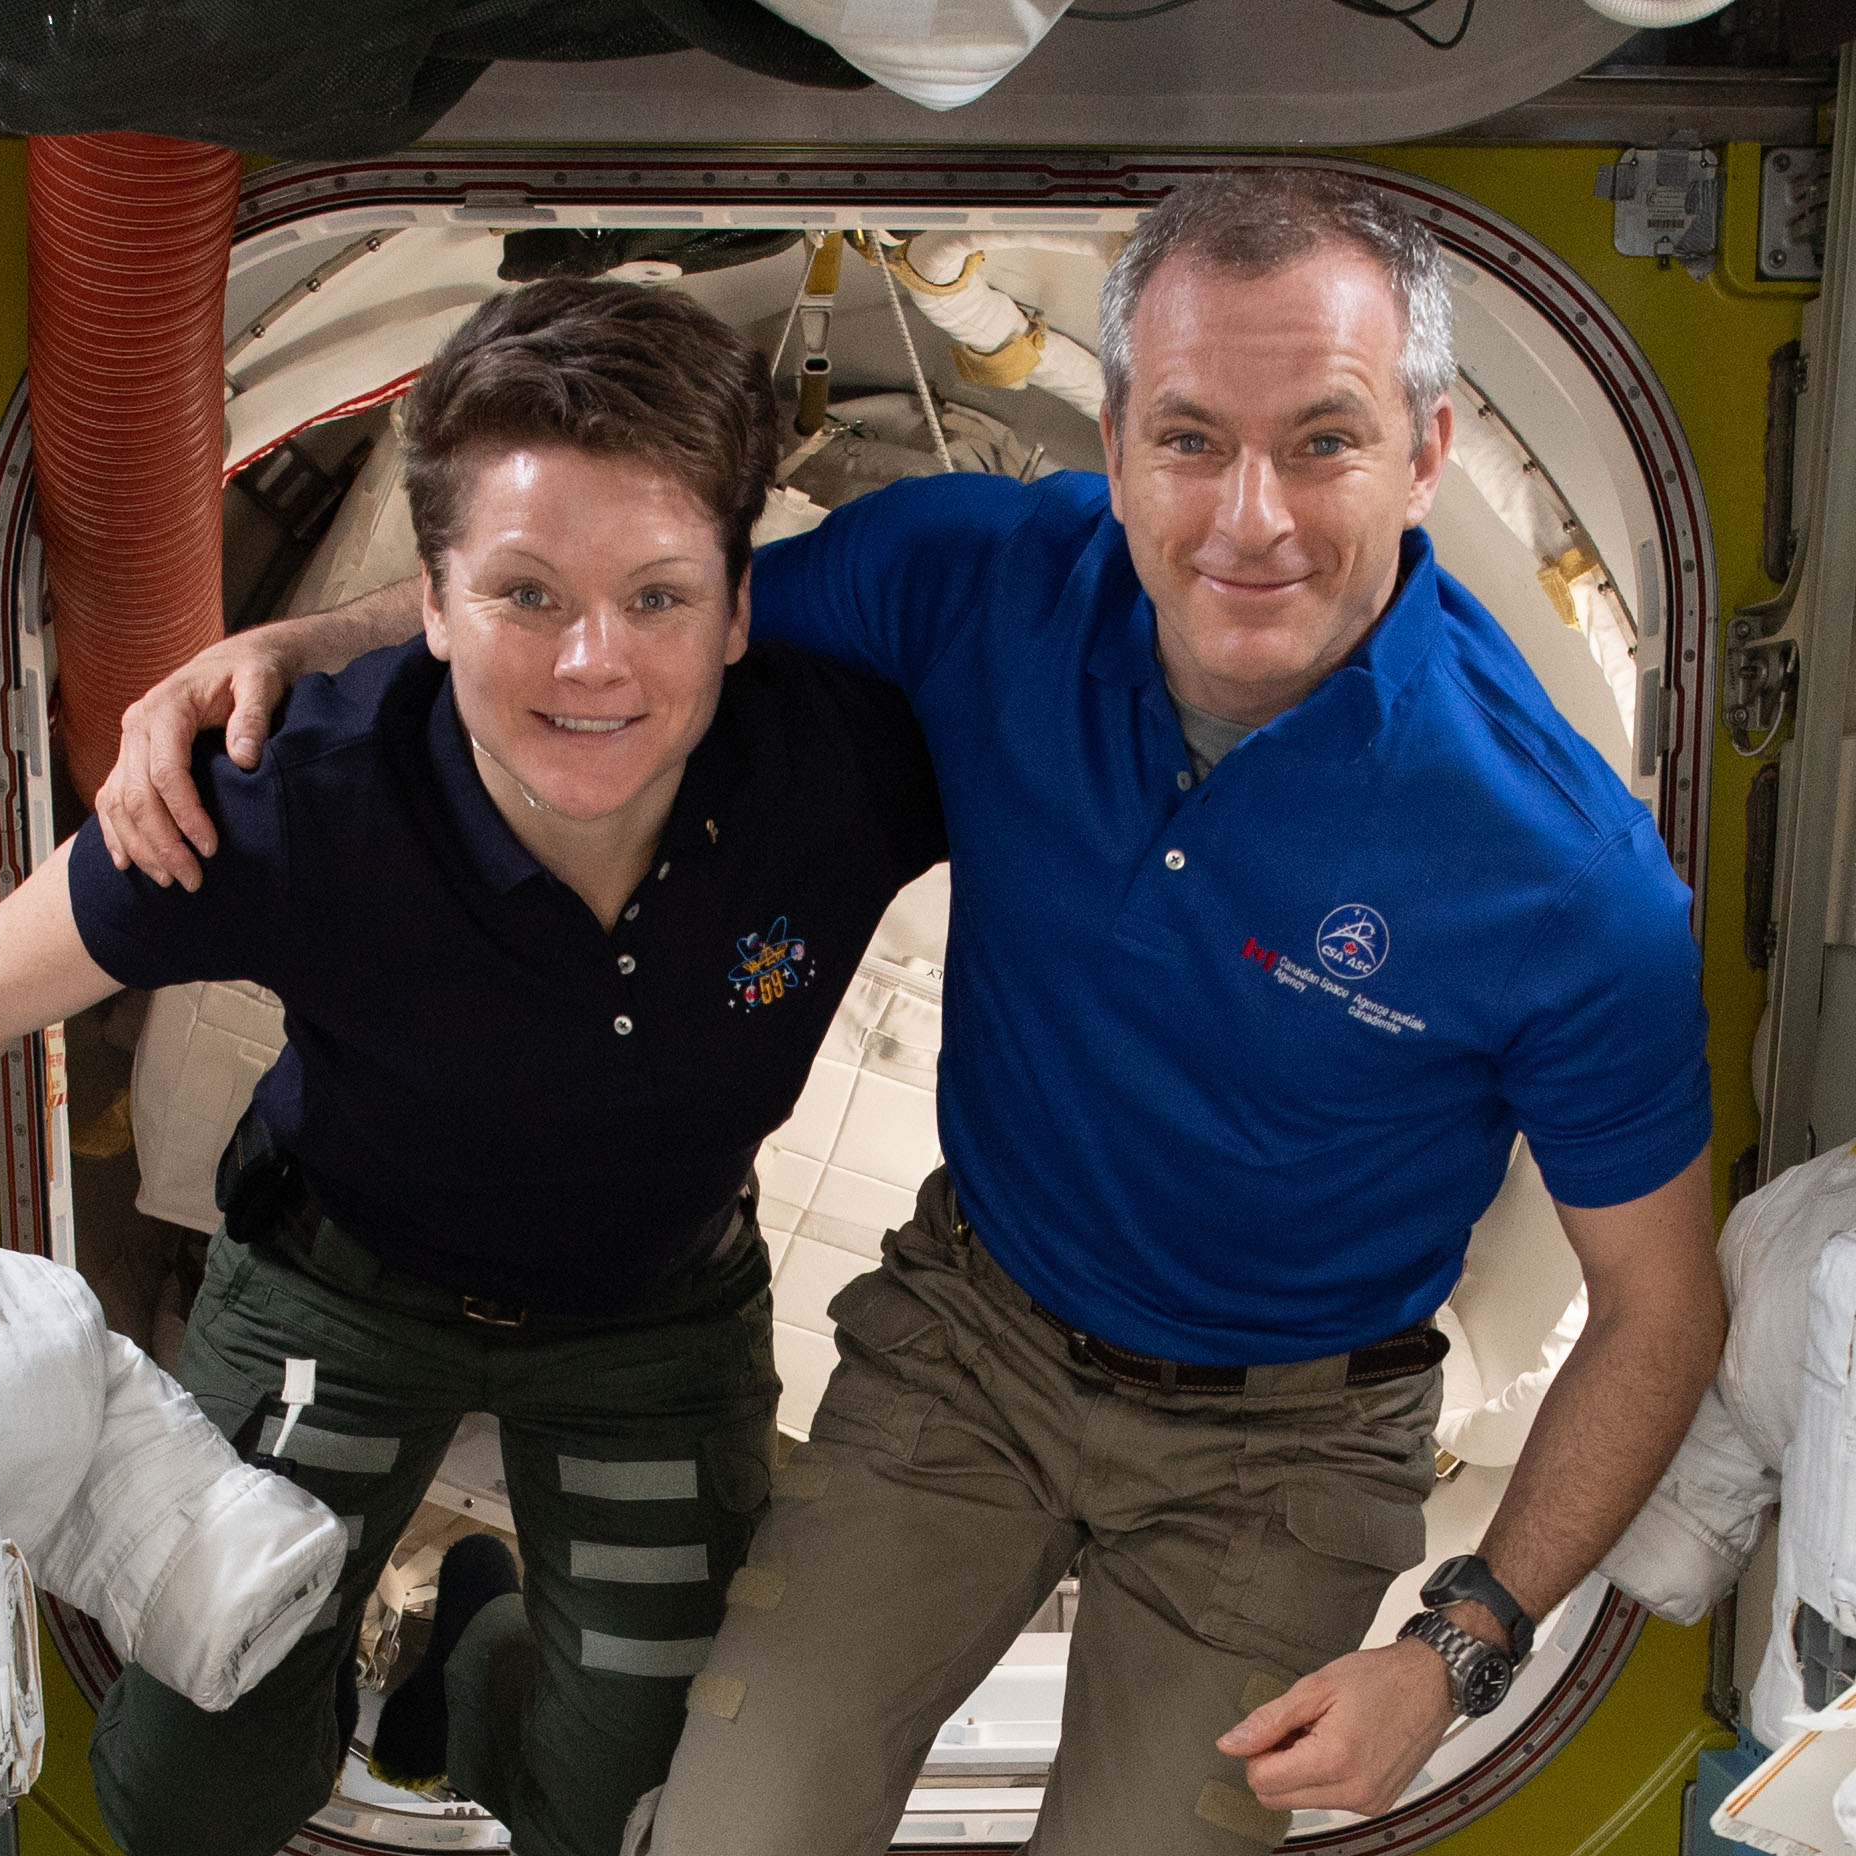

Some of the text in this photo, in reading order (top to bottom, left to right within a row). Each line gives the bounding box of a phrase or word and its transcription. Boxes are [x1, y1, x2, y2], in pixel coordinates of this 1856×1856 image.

[1321, 944, 1372, 974] CSA ASC
[759, 969, 785, 1005] 59
[1273, 968, 1308, 994] Agency
[1279, 955, 1350, 999] Canadian Space
[1348, 1005, 1401, 1034] canadienne
[1353, 993, 1426, 1032] Agence spatiale
